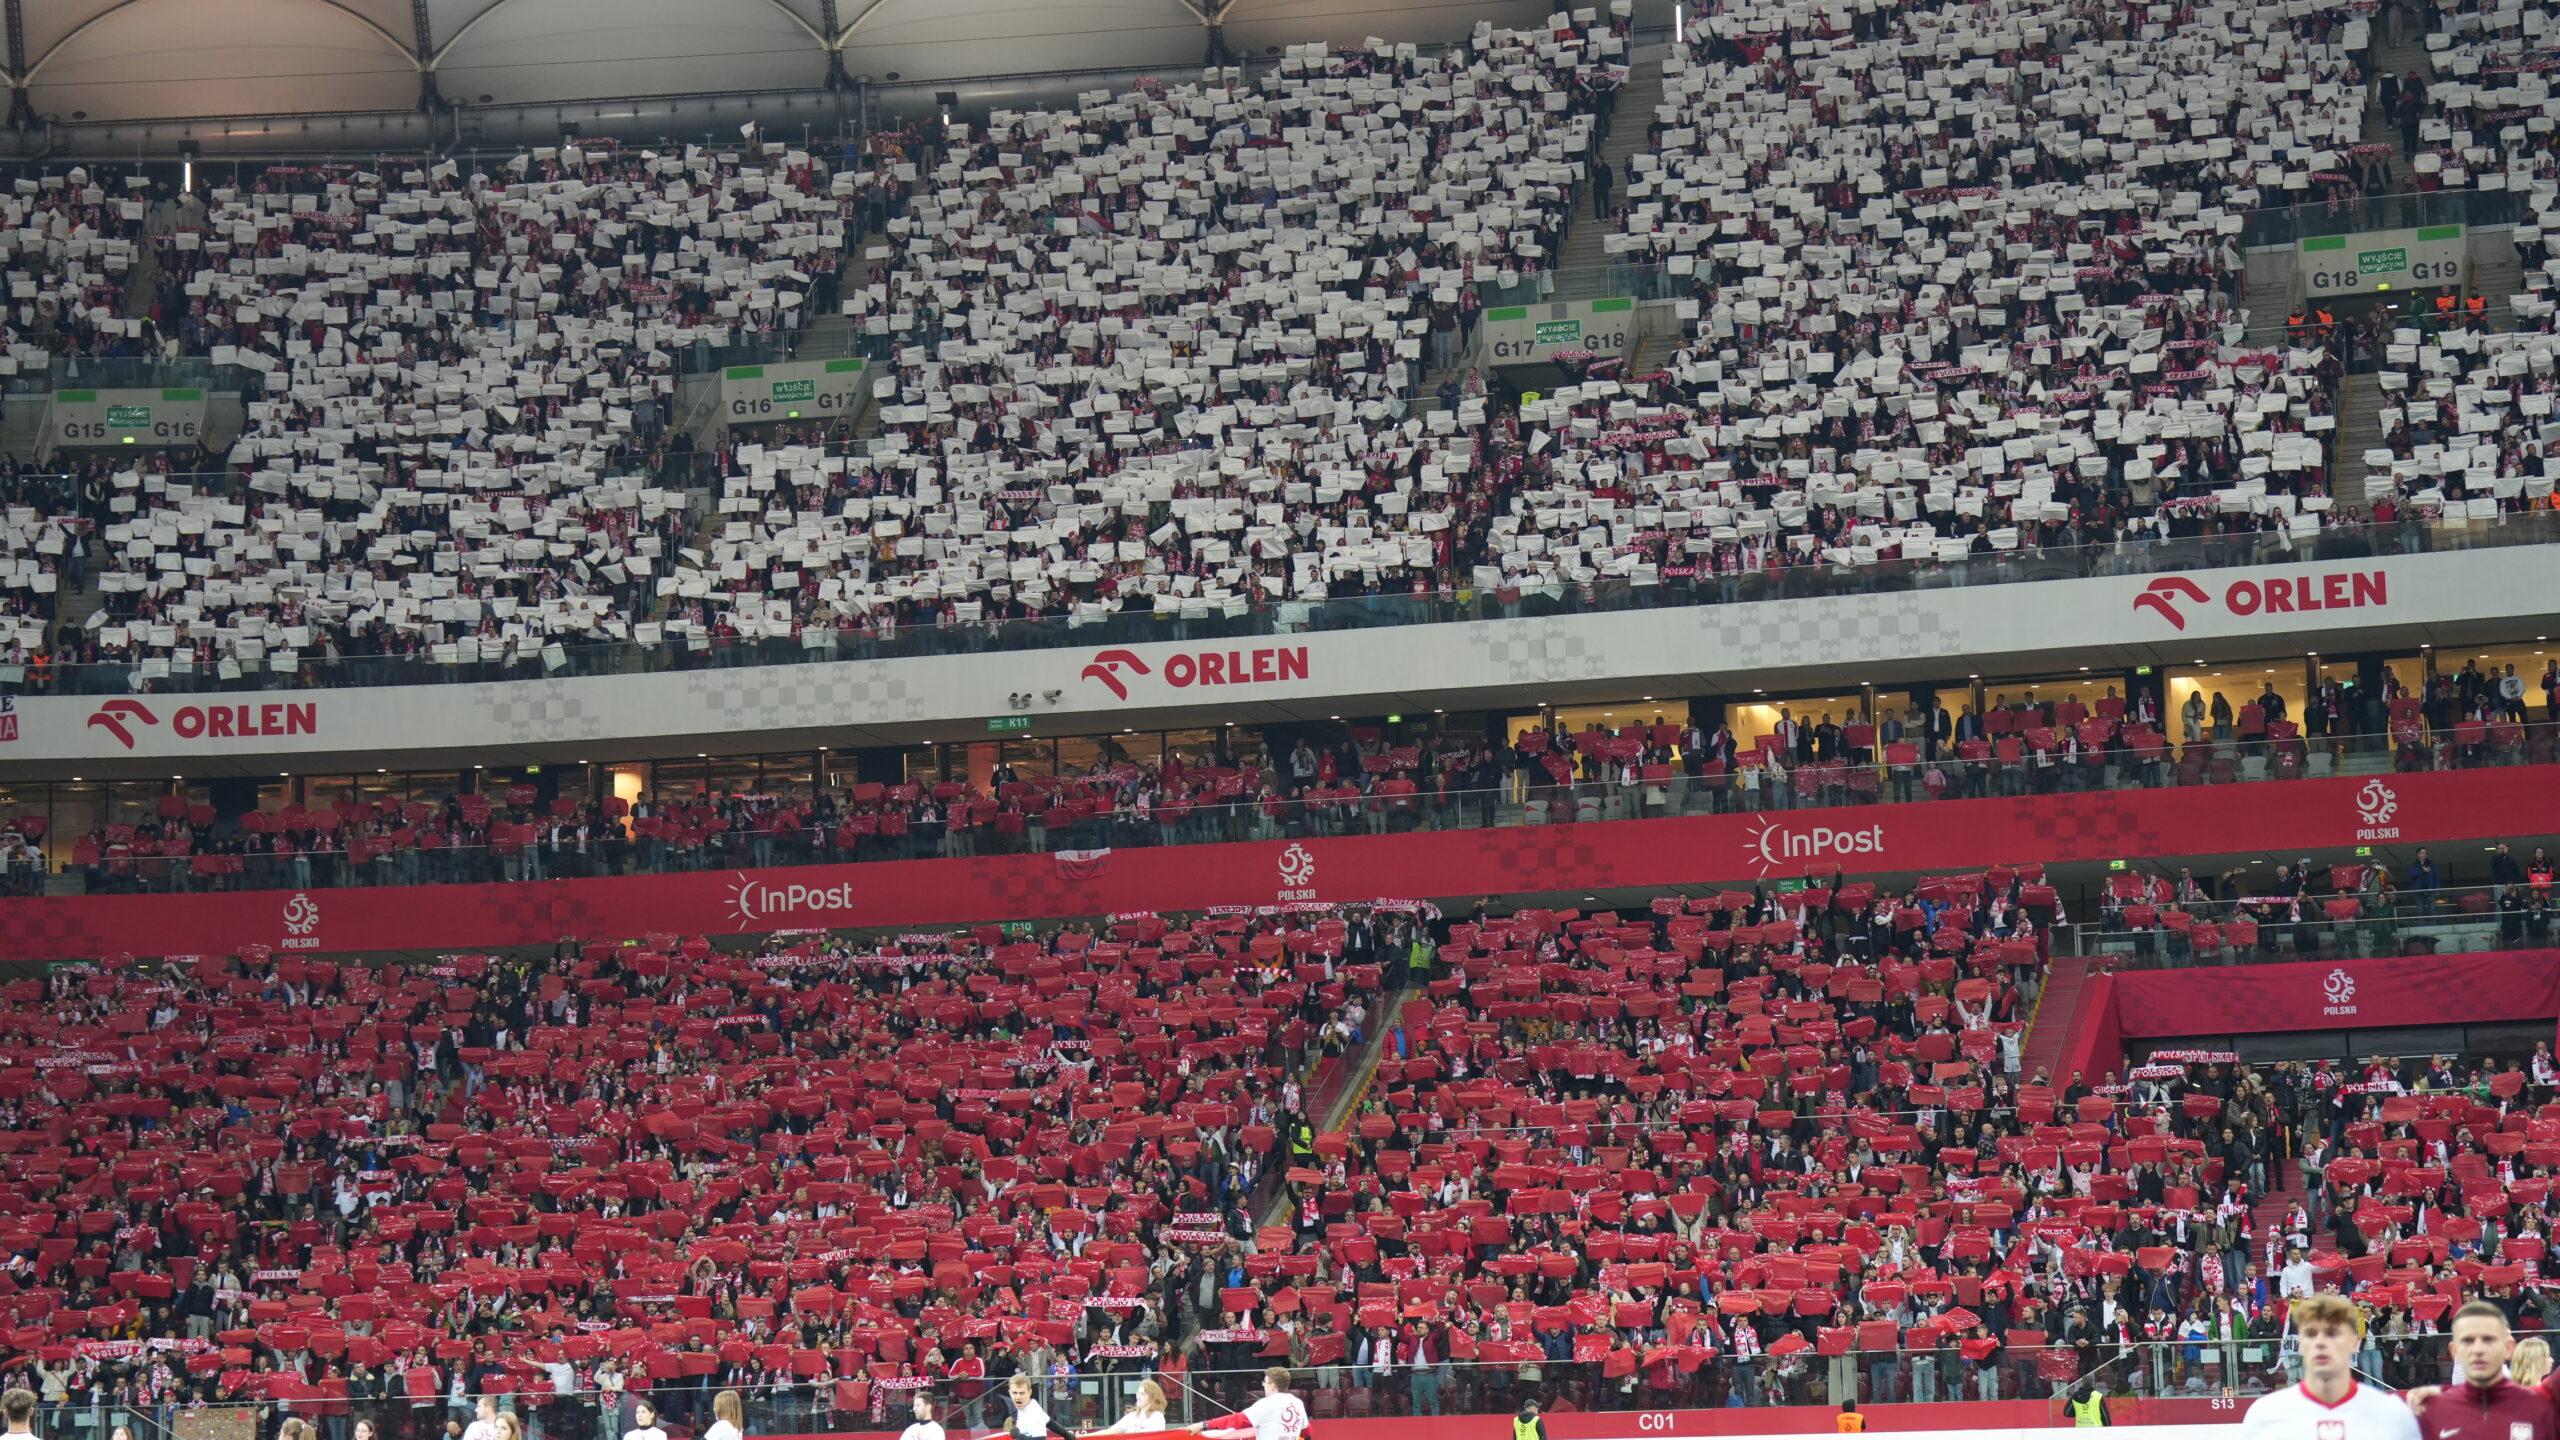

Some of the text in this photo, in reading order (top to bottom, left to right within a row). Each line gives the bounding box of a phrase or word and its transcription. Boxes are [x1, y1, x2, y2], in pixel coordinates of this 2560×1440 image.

[2362, 252, 2402, 264] WYJŚCIE
[2412, 261, 2457, 280] G19
[2313, 271, 2358, 289] G18
[1584, 333, 1624, 350] G18
[1494, 341, 1535, 358] G17
[818, 391, 857, 408] G17
[732, 398, 771, 415] G16
[64, 423, 105, 438] G15
[155, 421, 195, 437] G16
[1665, 567, 1694, 576] POLSKA
[2226, 571, 2387, 615] ORLEN
[1165, 647, 1308, 687] ORLEN
[173, 703, 316, 738] ORLEN
[1009, 717, 1028, 727] K11
[2357, 828, 2399, 840] POLSKA
[1784, 825, 1884, 857] InPost
[761, 882, 852, 912] InPost
[1278, 889, 1316, 901] POLSKA
[1388, 898, 1420, 908] POLSKA
[1120, 912, 1148, 920] POLSKA
[283, 938, 320, 949] POLSKA
[2324, 1006, 2357, 1015] POLSKA
[721, 1014, 758, 1024] POL SKA
[2193, 1052, 2234, 1063] POLSKA
[2135, 1067, 2177, 1078] POLSKA
[1174, 1230, 1220, 1242] POLSKA
[2037, 1228, 2071, 1237] POLSKA
[260, 1270, 299, 1278] POLSKA
[1209, 1331, 1226, 1339] POL
[94, 1346, 134, 1358] POLSKA
[2212, 1399, 2235, 1409] S13
[1639, 1413, 1674, 1430] C01
